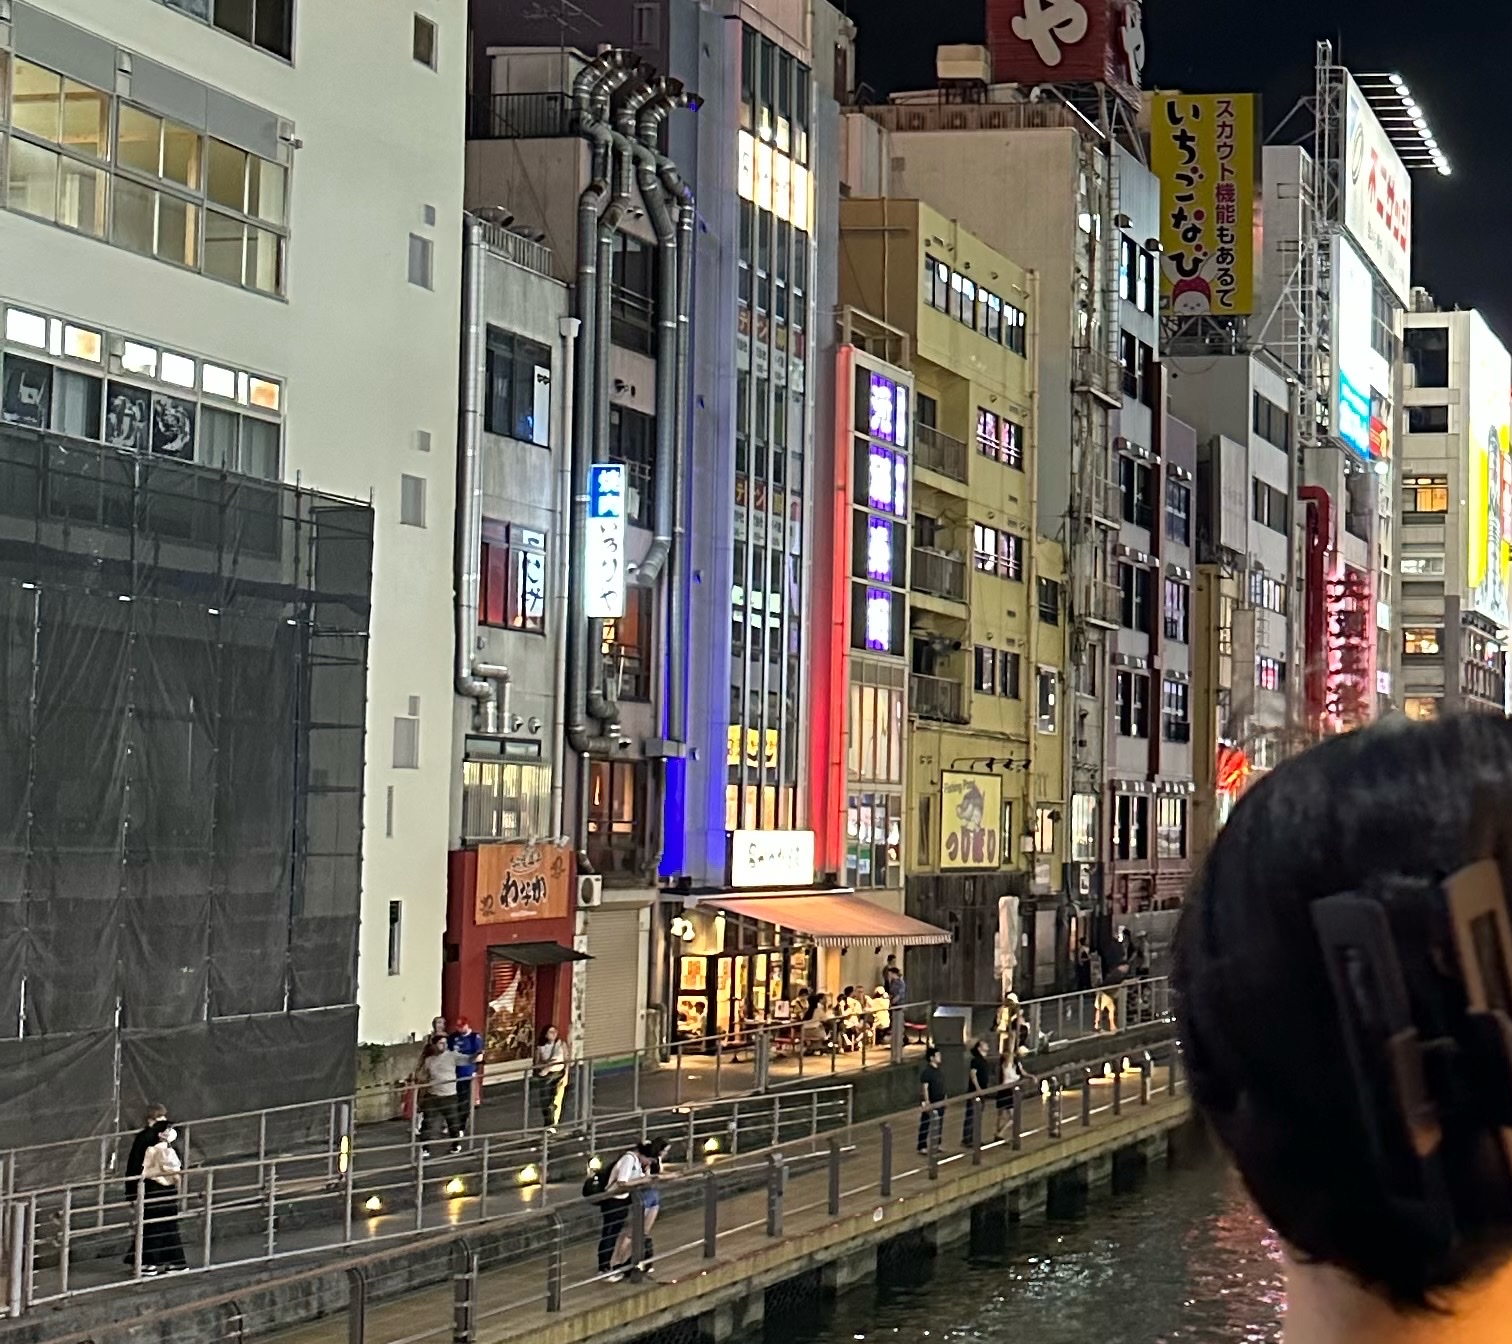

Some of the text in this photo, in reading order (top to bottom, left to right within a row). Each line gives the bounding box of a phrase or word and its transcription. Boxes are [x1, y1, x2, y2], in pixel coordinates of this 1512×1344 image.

[1167, 101, 1209, 278] いちごなび
